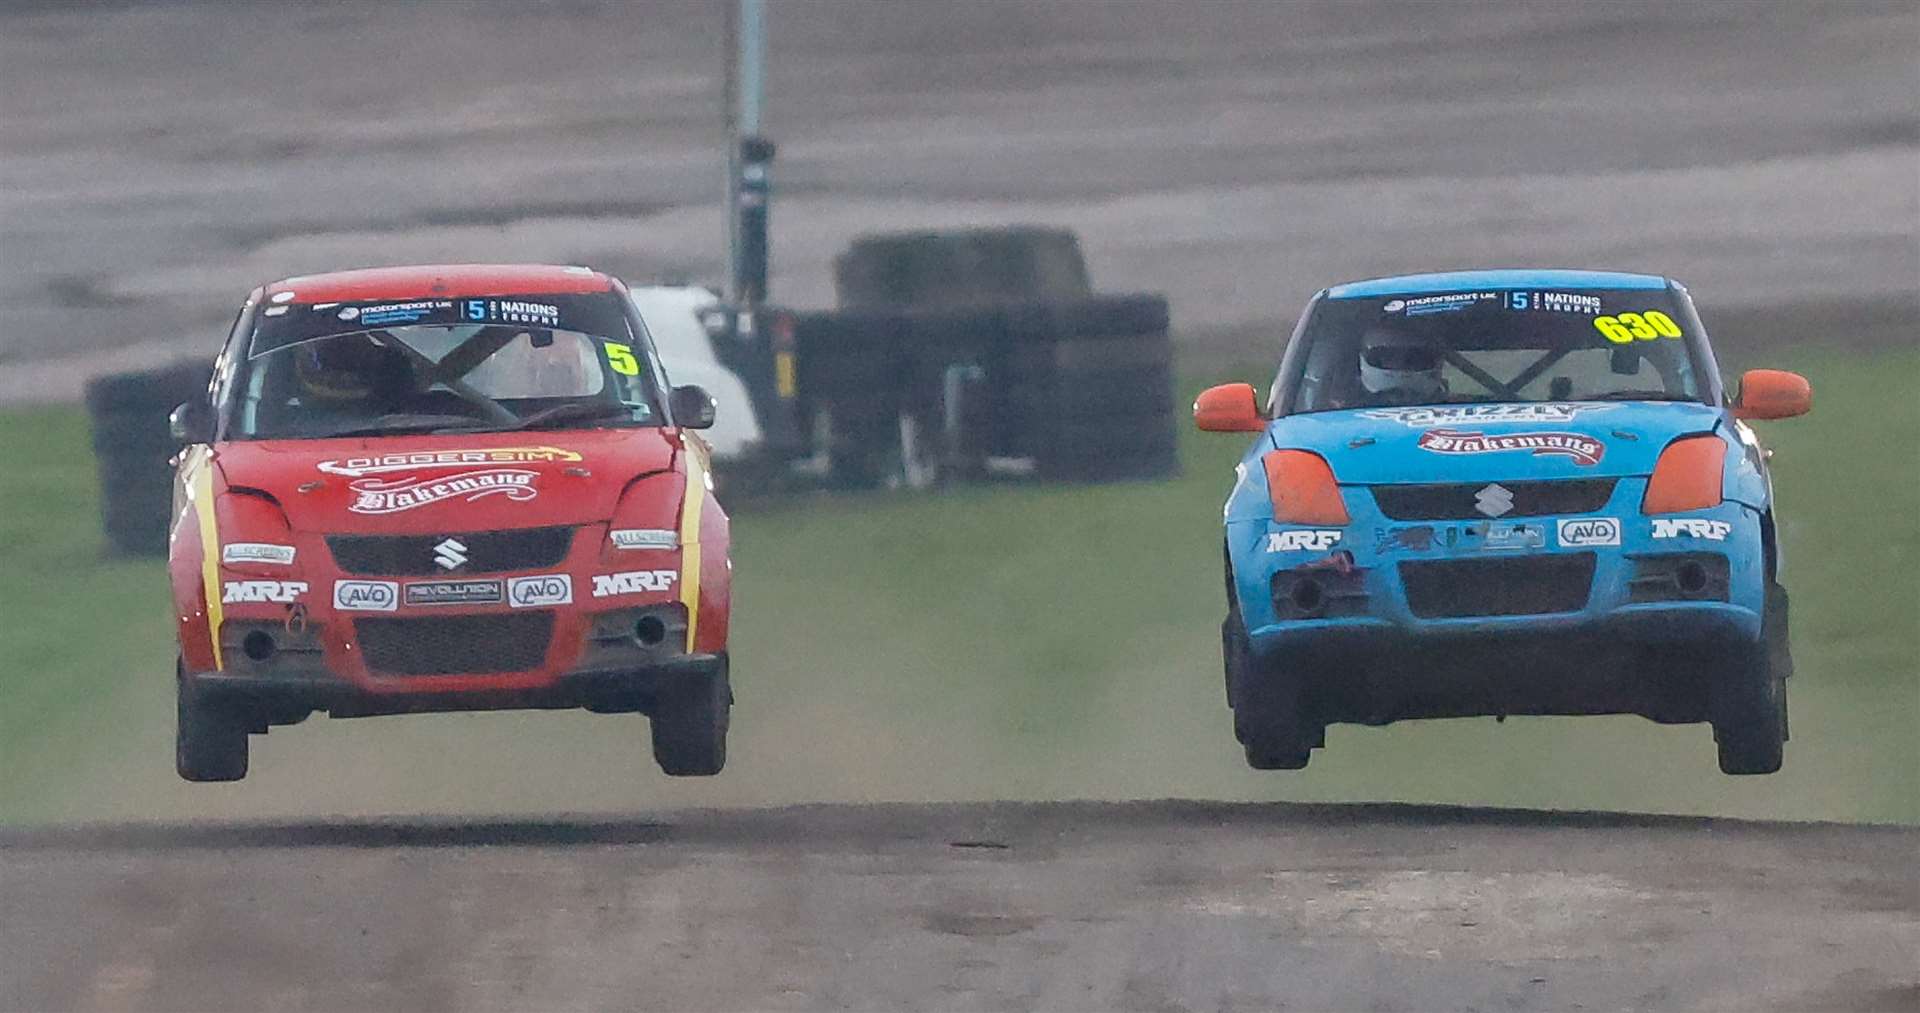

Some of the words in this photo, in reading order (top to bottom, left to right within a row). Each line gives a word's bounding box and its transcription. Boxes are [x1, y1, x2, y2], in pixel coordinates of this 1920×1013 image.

[361, 301, 433, 314] motorsport
[468, 300, 486, 320] 5
[501, 301, 559, 317] NATIONS
[1407, 292, 1478, 306] motorsport
[1512, 292, 1529, 309] 5
[1544, 292, 1600, 307] NATIONS
[1545, 303, 1600, 315] TROPHY
[502, 312, 559, 327] TROPHY
[1593, 310, 1683, 344] 630
[603, 341, 641, 377] 5
[1266, 530, 1342, 552] MRF
[1572, 521, 1608, 544] AVO
[1651, 518, 1732, 542] MRF
[222, 581, 309, 604] MRF
[349, 583, 385, 606] AVO
[522, 578, 560, 604] AVO
[591, 570, 677, 597] MRF
